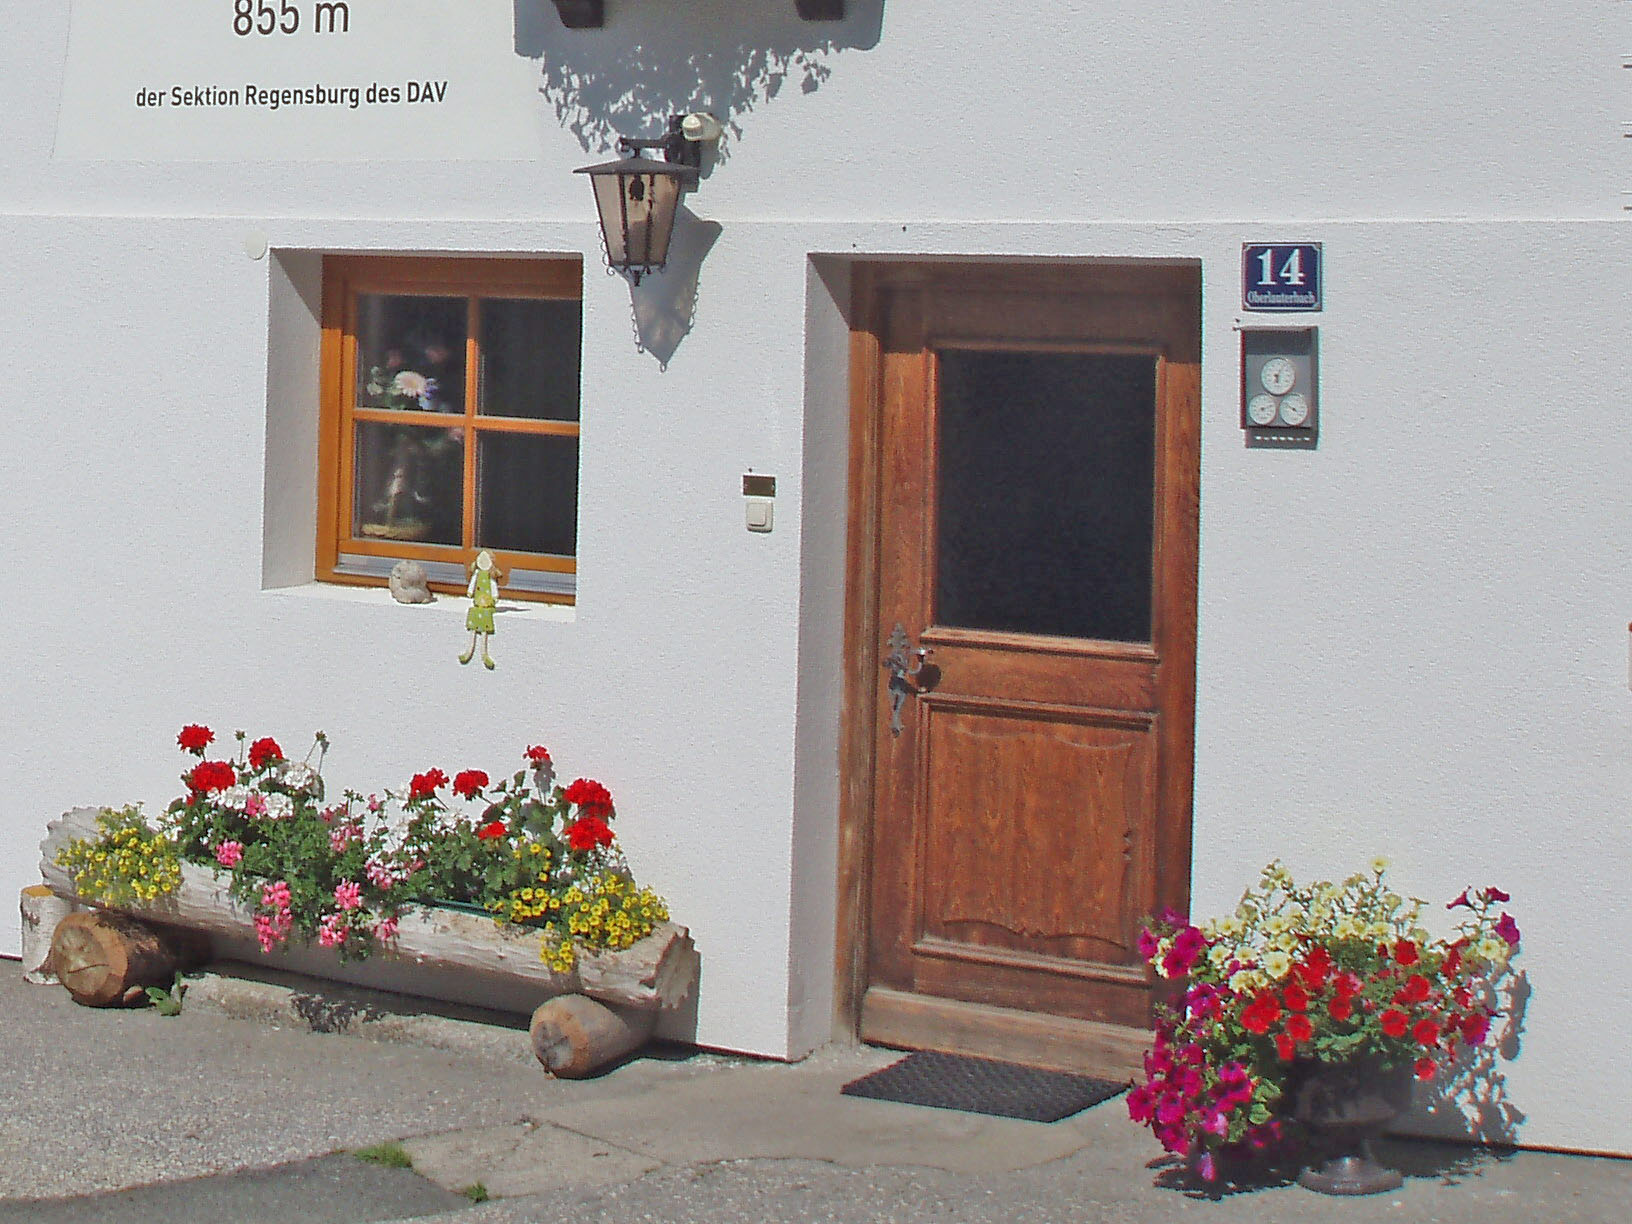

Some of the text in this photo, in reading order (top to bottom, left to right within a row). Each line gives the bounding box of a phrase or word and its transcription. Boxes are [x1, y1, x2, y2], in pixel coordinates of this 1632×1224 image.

[314, 1, 350, 34] m
[136, 80, 449, 111] der Sektion Regensburg des DAV
[1256, 248, 1306, 285] 14
